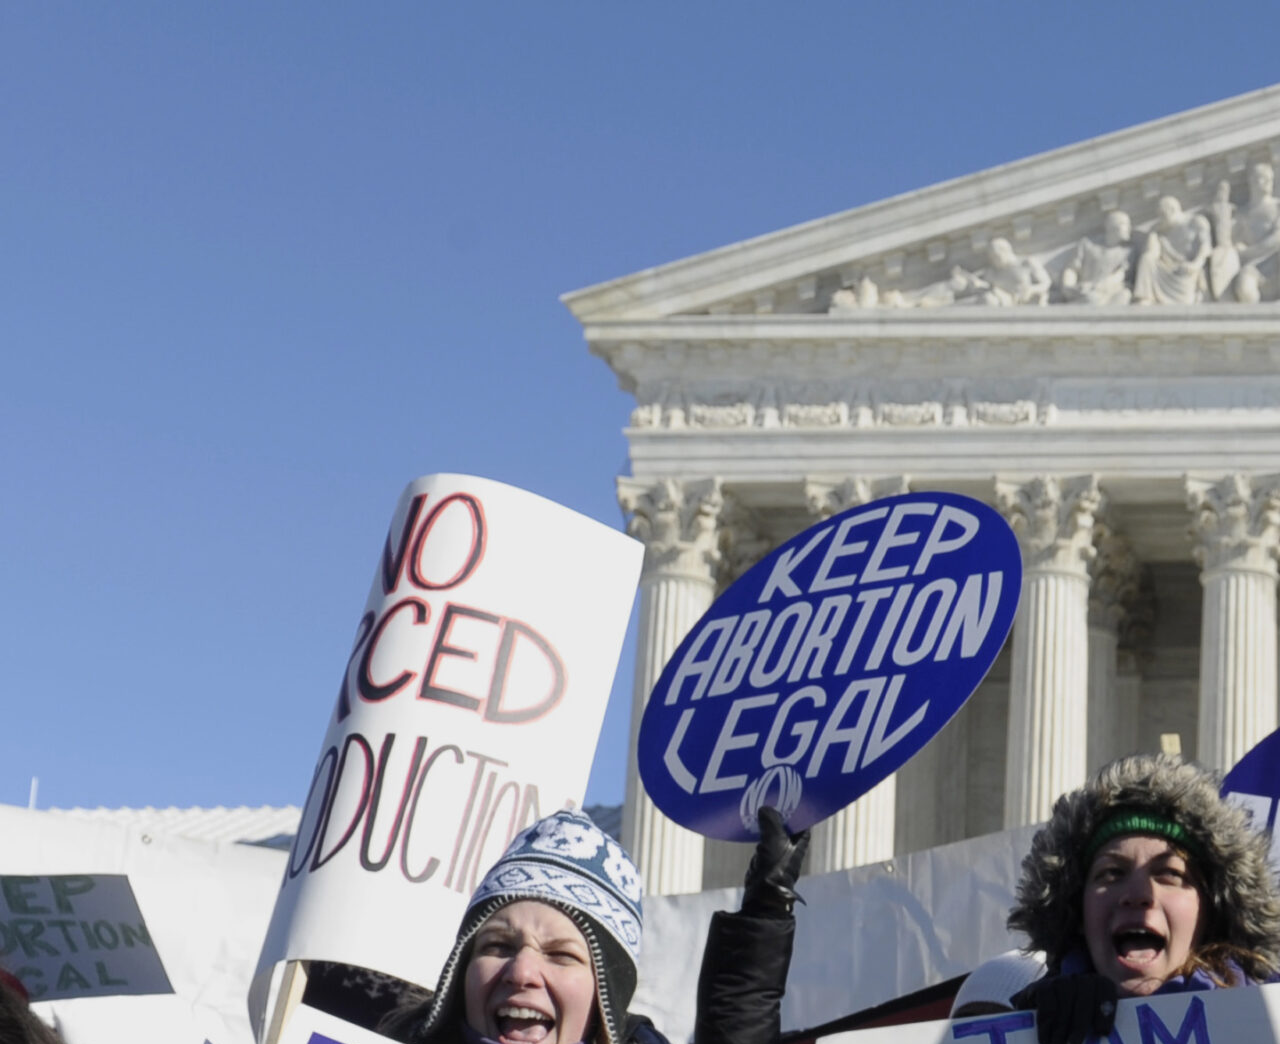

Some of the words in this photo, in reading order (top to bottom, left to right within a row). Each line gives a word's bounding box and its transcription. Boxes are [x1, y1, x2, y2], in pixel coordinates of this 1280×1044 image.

[758, 503, 980, 603] KEEP
[665, 571, 1003, 705] ABORTION
[664, 674, 929, 795] LEGAL
